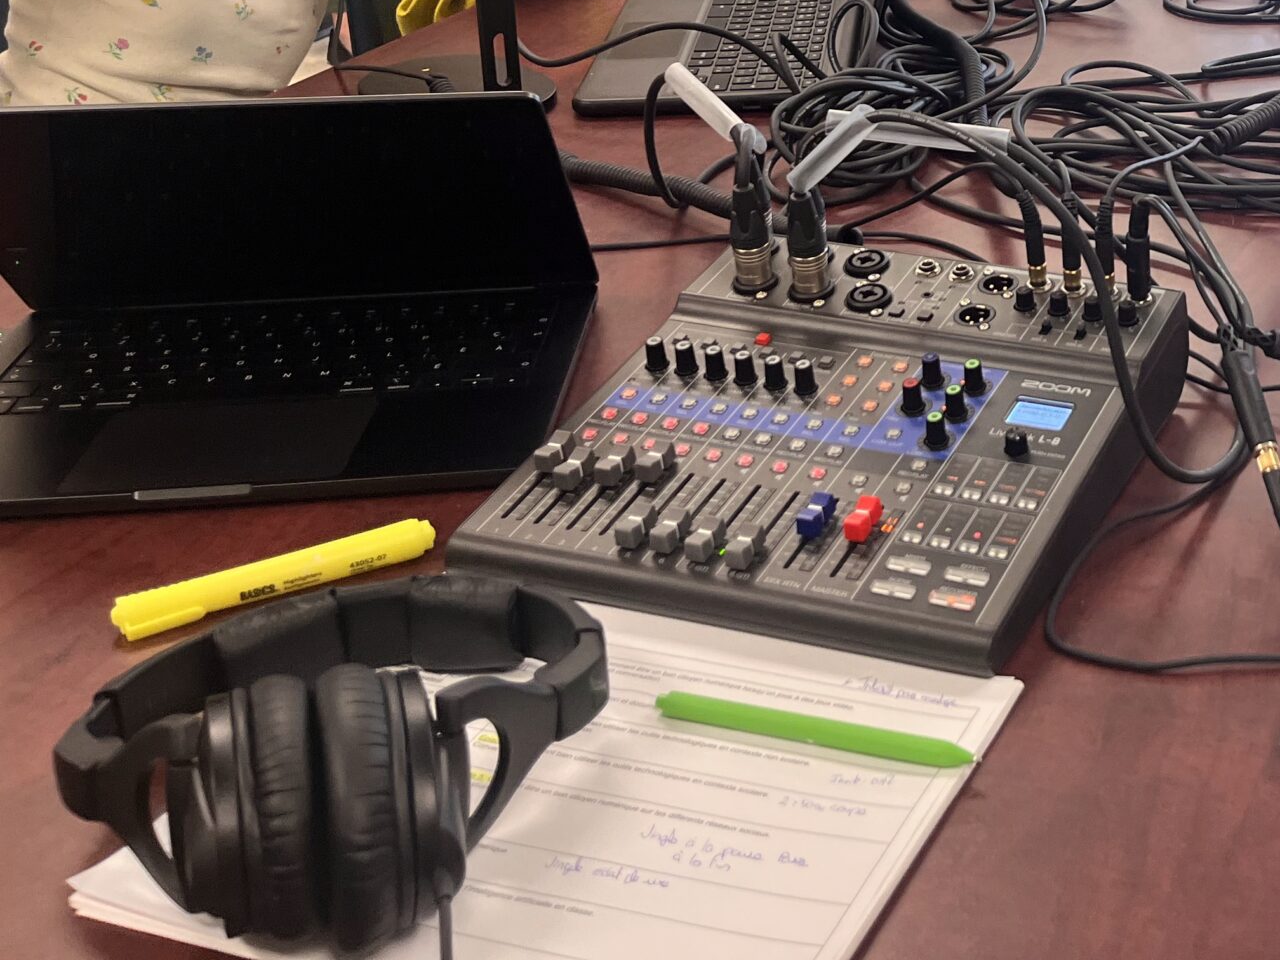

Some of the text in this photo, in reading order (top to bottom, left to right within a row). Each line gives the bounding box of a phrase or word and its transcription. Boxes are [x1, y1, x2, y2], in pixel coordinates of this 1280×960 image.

[1021, 379, 1092, 397] ZOOM
[1038, 434, 1061, 446] L-8
[240, 584, 276, 601] BASICS
